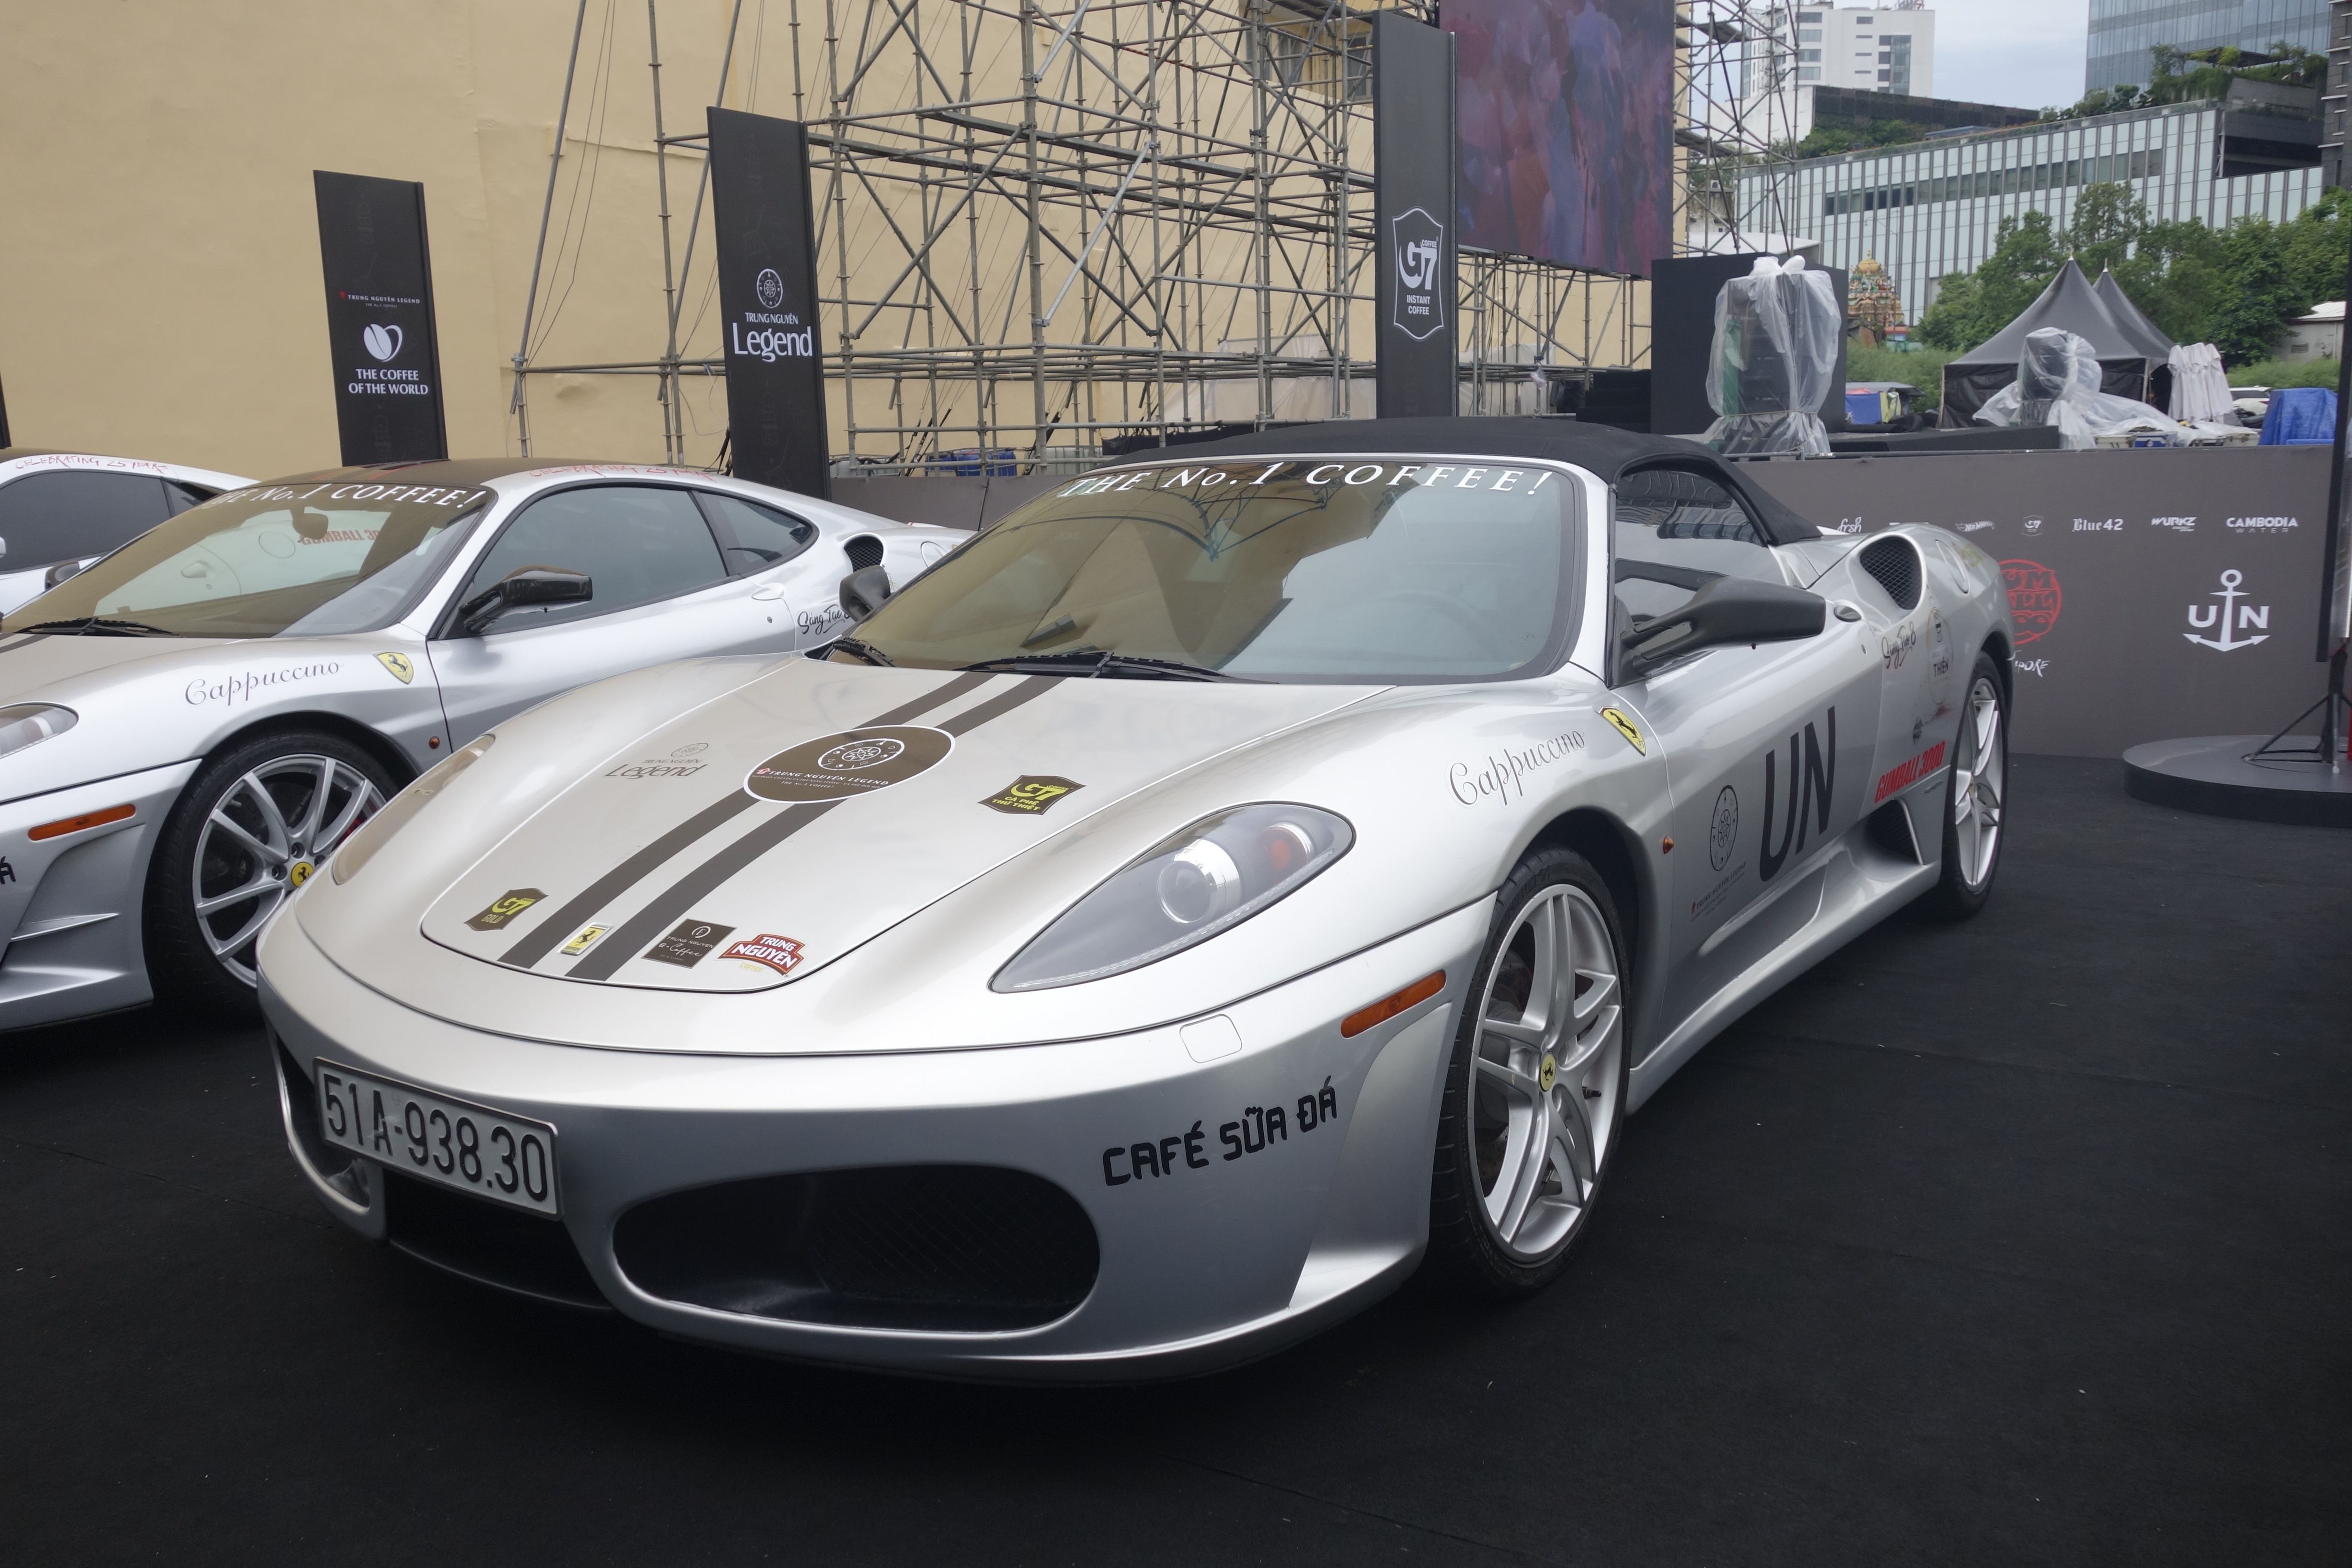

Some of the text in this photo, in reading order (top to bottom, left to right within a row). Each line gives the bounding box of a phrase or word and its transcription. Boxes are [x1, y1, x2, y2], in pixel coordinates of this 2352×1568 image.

[1421, 239, 1437, 248] COFFEE
[1399, 241, 1437, 290] G7
[1407, 294, 1430, 304] INSTANT
[745, 312, 798, 324] TRUNG NGUYÊN
[1408, 306, 1430, 315] COFFEE
[732, 322, 813, 362] Legend
[356, 369, 419, 380] THE COFFEE
[349, 383, 429, 395] OF THE WORLD
[15, 455, 101, 469] CELEBRATING
[1059, 461, 1553, 497] THE No.1 COFFEE!
[249, 484, 332, 501] No.1
[331, 484, 486, 508] COFFEE!
[1837, 516, 1862, 533] frsh
[2071, 518, 2123, 532] Blue 42
[2151, 517, 2197, 526] WURKZ
[2226, 517, 2298, 527] CAMBODIA
[185, 662, 344, 706] Cappuccino
[604, 764, 708, 779] Legend
[1450, 731, 1585, 806] Cappuccino
[1874, 740, 1946, 804] GUMBALL 3000
[848, 777, 888, 785] LEGEND
[1011, 784, 1067, 801] G7
[1759, 705, 1836, 882] UN
[492, 897, 534, 915] G7
[481, 914, 504, 924] GOLD
[760, 937, 797, 951] TRUNG
[731, 943, 798, 968] NGUYÊN
[323, 1073, 548, 1202] 51A-938.30
[1102, 1075, 1337, 1186] CAFÉ SỮA ĐÁ
